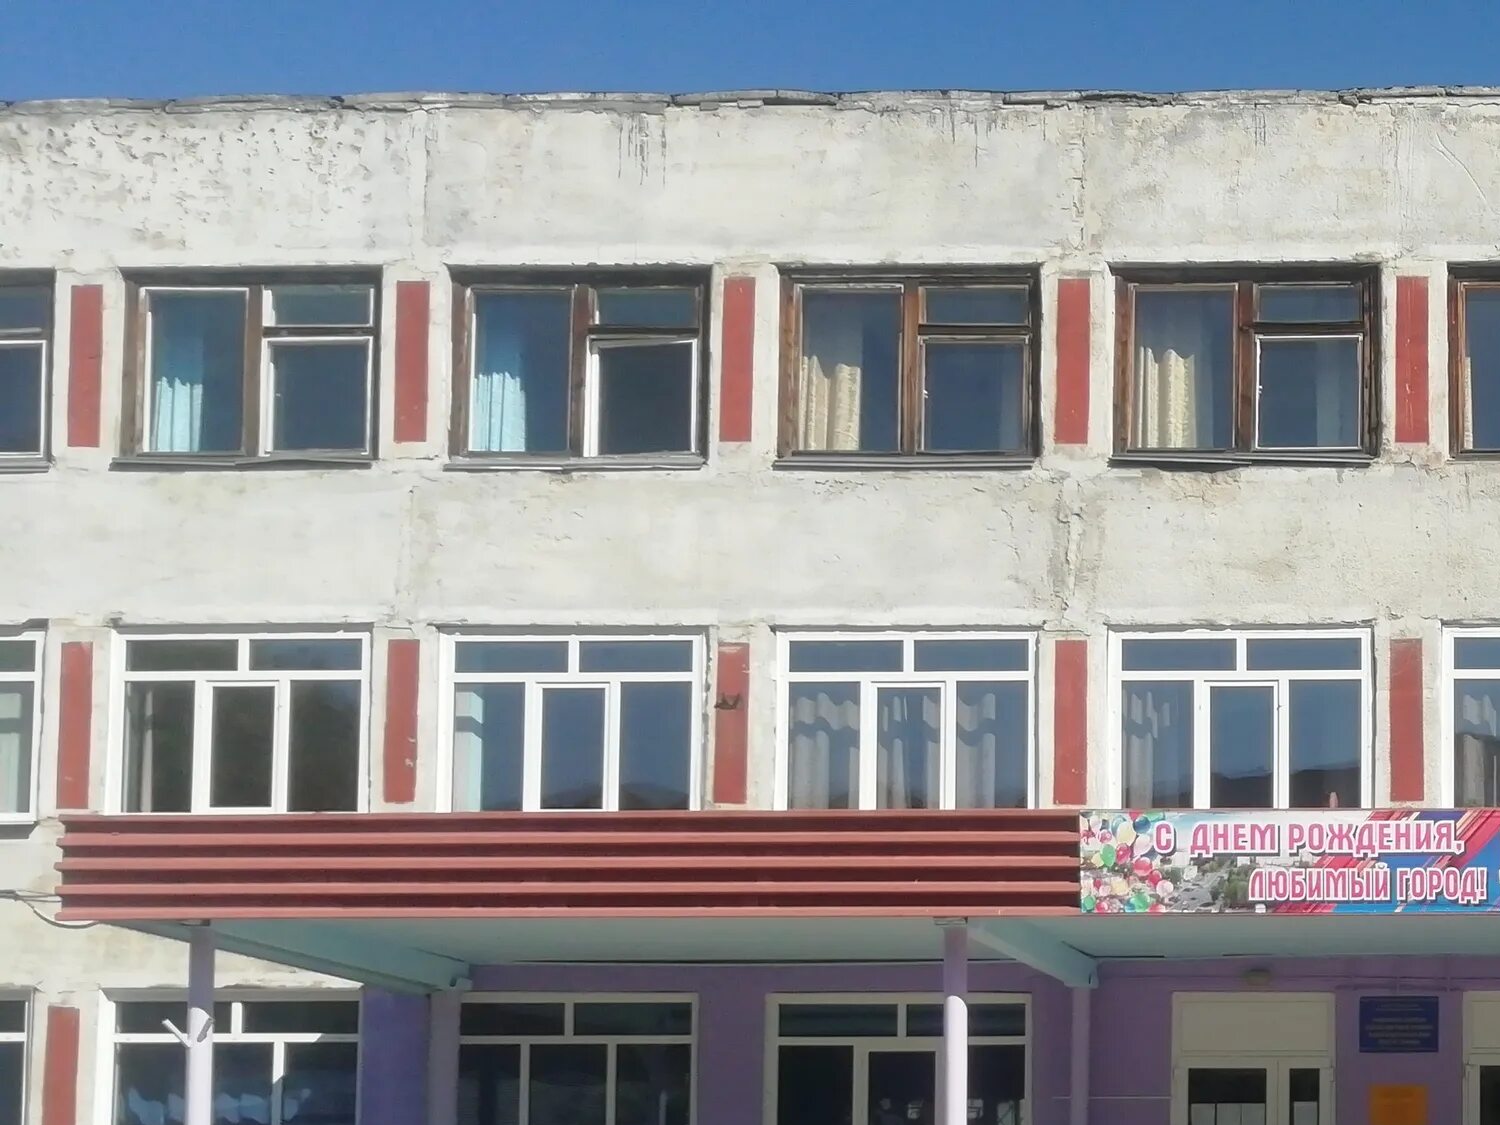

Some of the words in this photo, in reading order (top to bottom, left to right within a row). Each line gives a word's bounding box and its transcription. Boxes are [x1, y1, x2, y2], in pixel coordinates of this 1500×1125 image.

[1154, 823, 1173, 852] С
[1190, 822, 1278, 856] ДНЕМ
[1290, 821, 1464, 856] РОЖДЕНИЯ,
[1248, 863, 1388, 901] ЛЮБИМЫЙ
[1398, 866, 1487, 903] ГОРОД!
